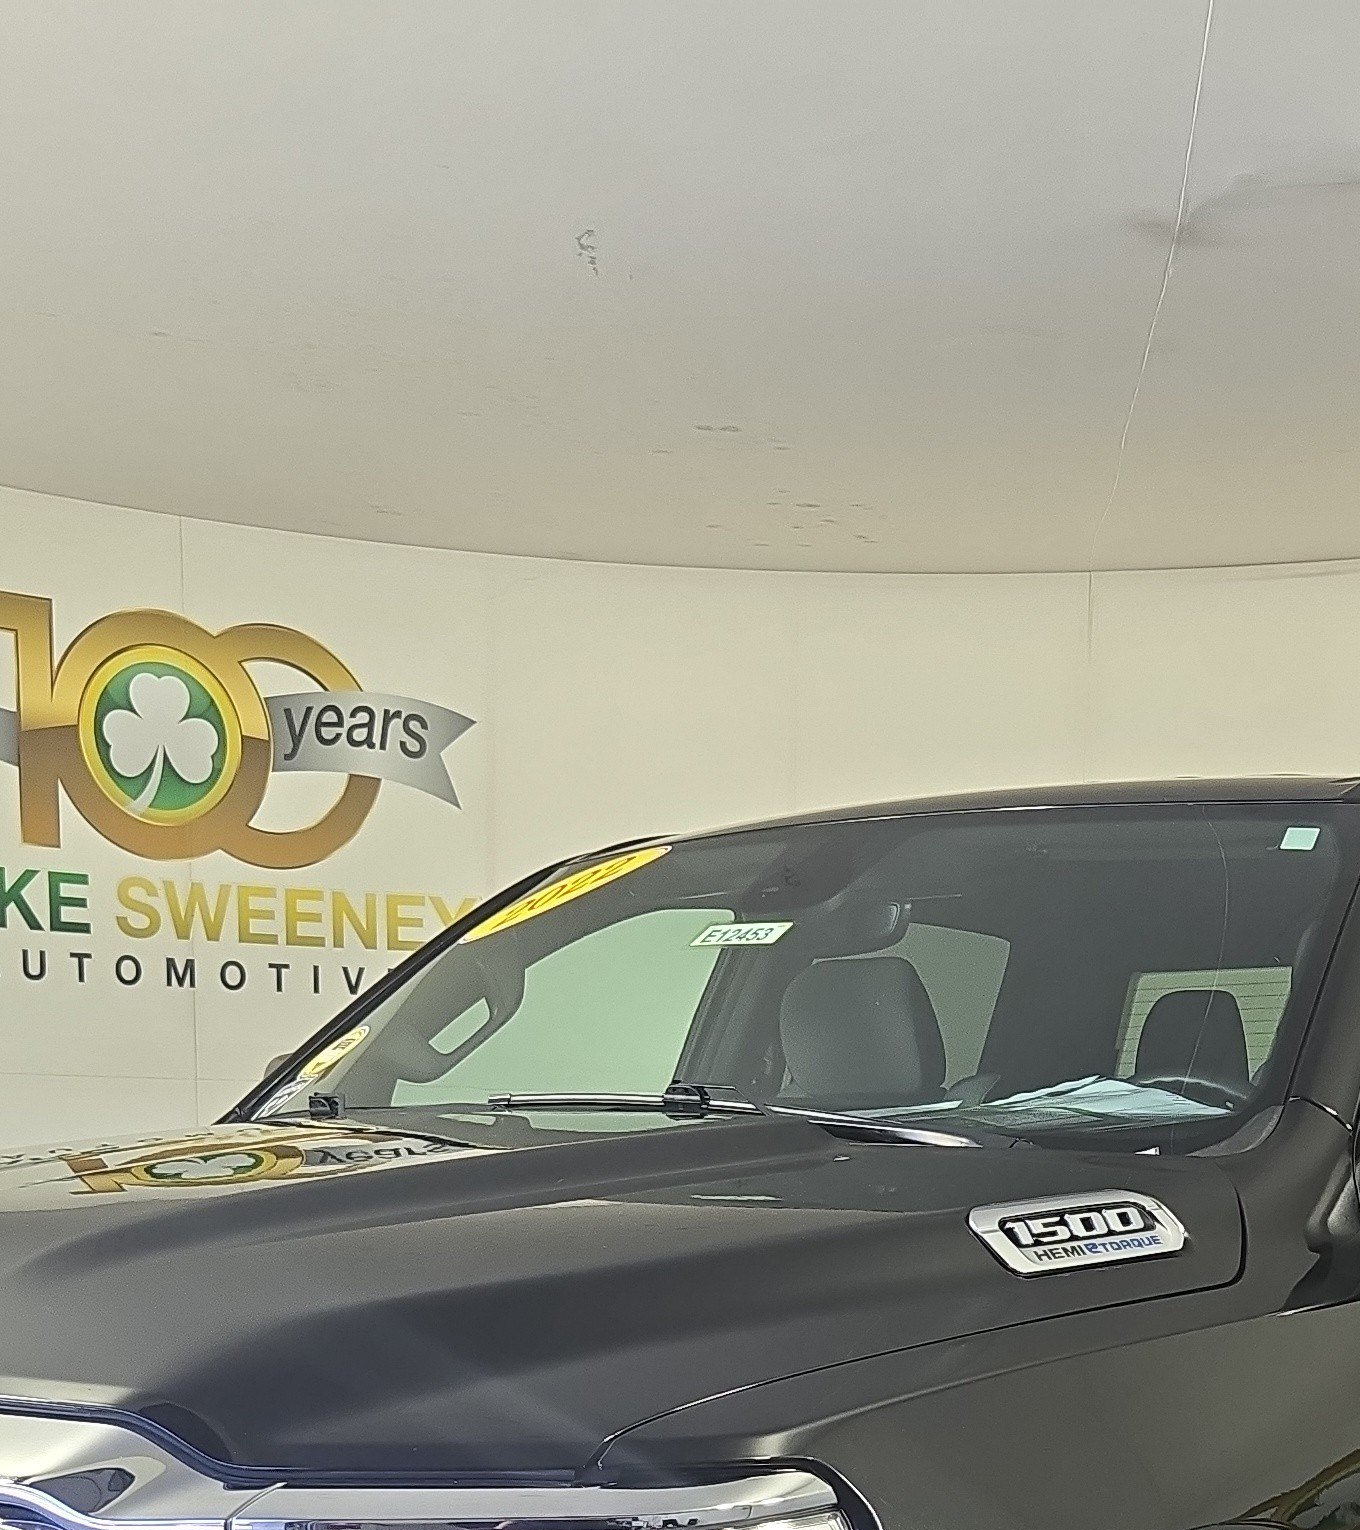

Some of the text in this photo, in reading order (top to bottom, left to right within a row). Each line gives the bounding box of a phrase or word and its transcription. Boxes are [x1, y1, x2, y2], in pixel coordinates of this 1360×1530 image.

[283, 703, 429, 761] years
[490, 855, 639, 931] 2022
[701, 928, 776, 943] E12453
[1004, 1207, 1146, 1245] 1500
[1033, 1243, 1087, 1261] HEMI
